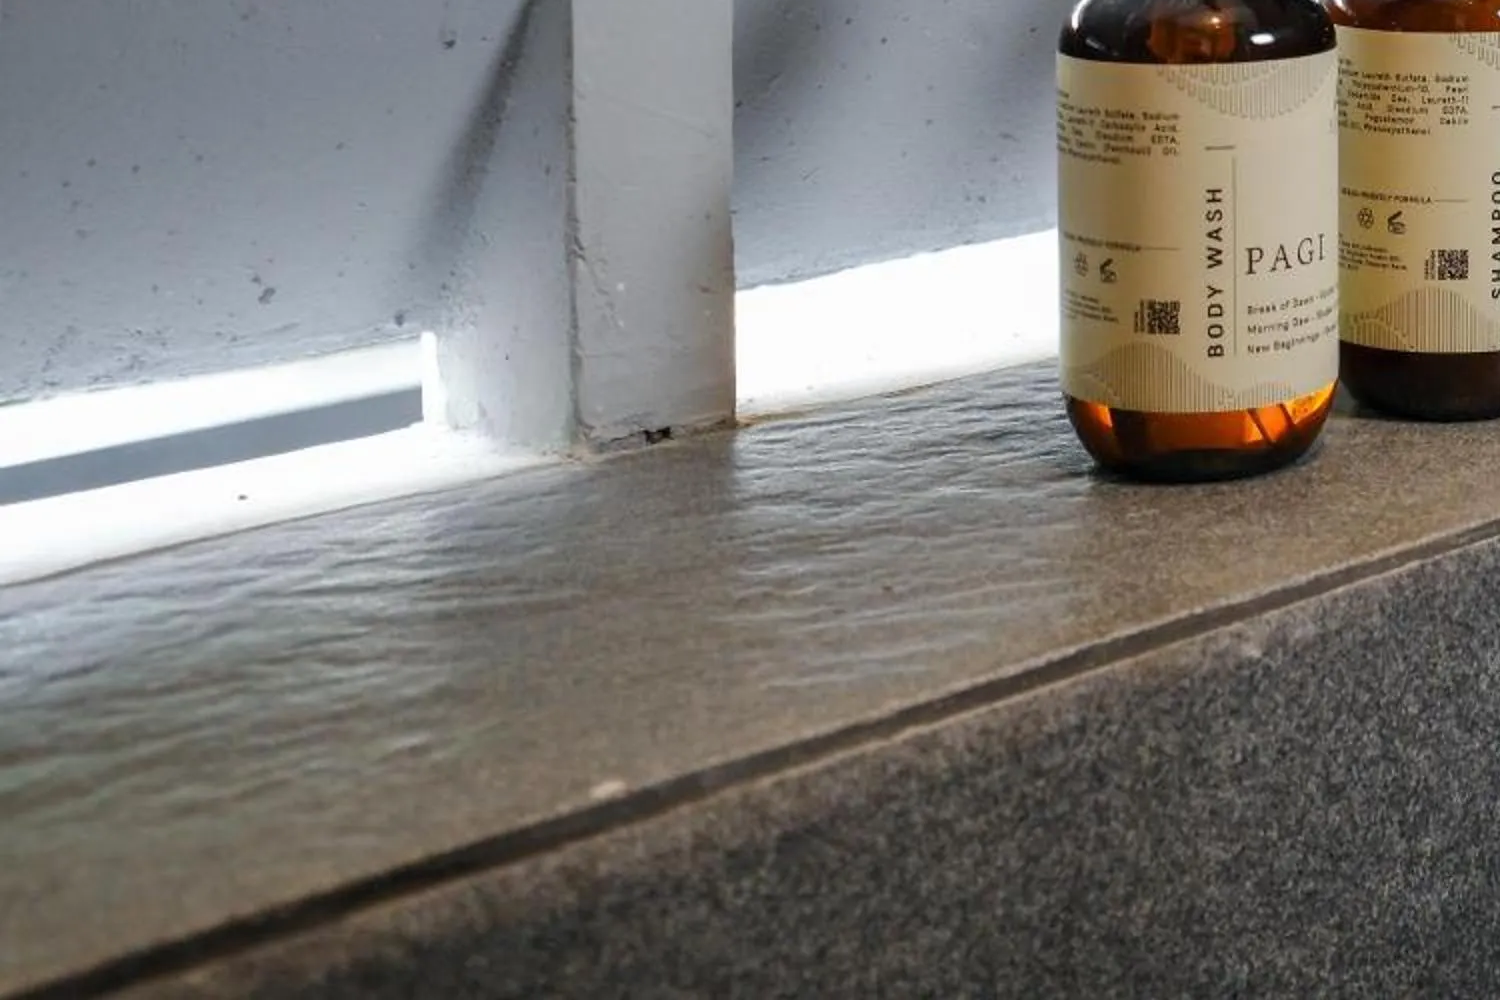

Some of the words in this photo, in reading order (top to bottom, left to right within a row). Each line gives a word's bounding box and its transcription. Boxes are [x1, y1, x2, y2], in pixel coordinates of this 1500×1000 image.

[1205, 187, 1224, 270] WASH
[1244, 232, 1326, 276] PAGI
[1206, 284, 1225, 359] BODY
[1247, 304, 1277, 316] Break
[1247, 320, 1290, 334] Morning
[1247, 343, 1272, 354] New
